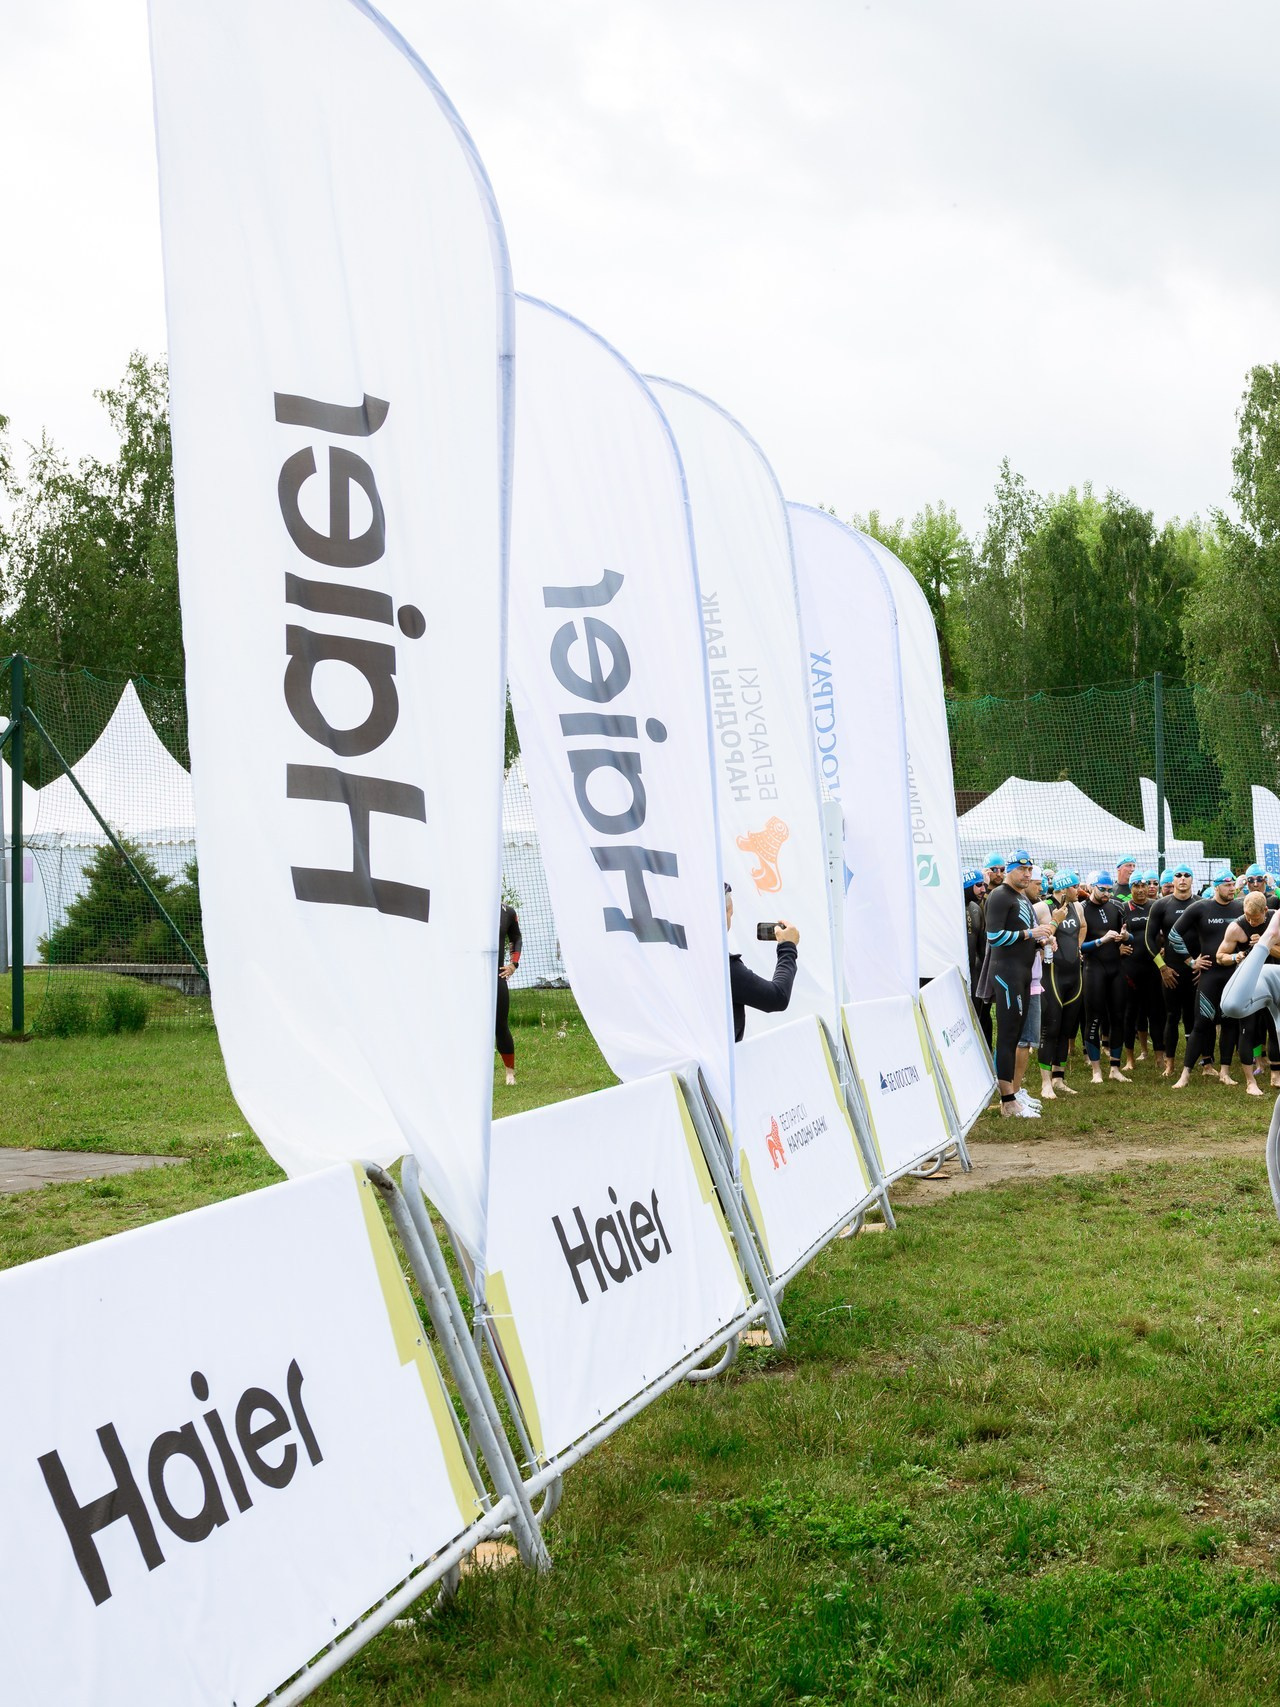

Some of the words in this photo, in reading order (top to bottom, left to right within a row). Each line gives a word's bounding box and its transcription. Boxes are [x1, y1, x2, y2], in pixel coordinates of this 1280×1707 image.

[1055, 877, 1073, 889] STAR
[551, 1186, 672, 1305] Haier
[37, 1358, 324, 1607] Haier
